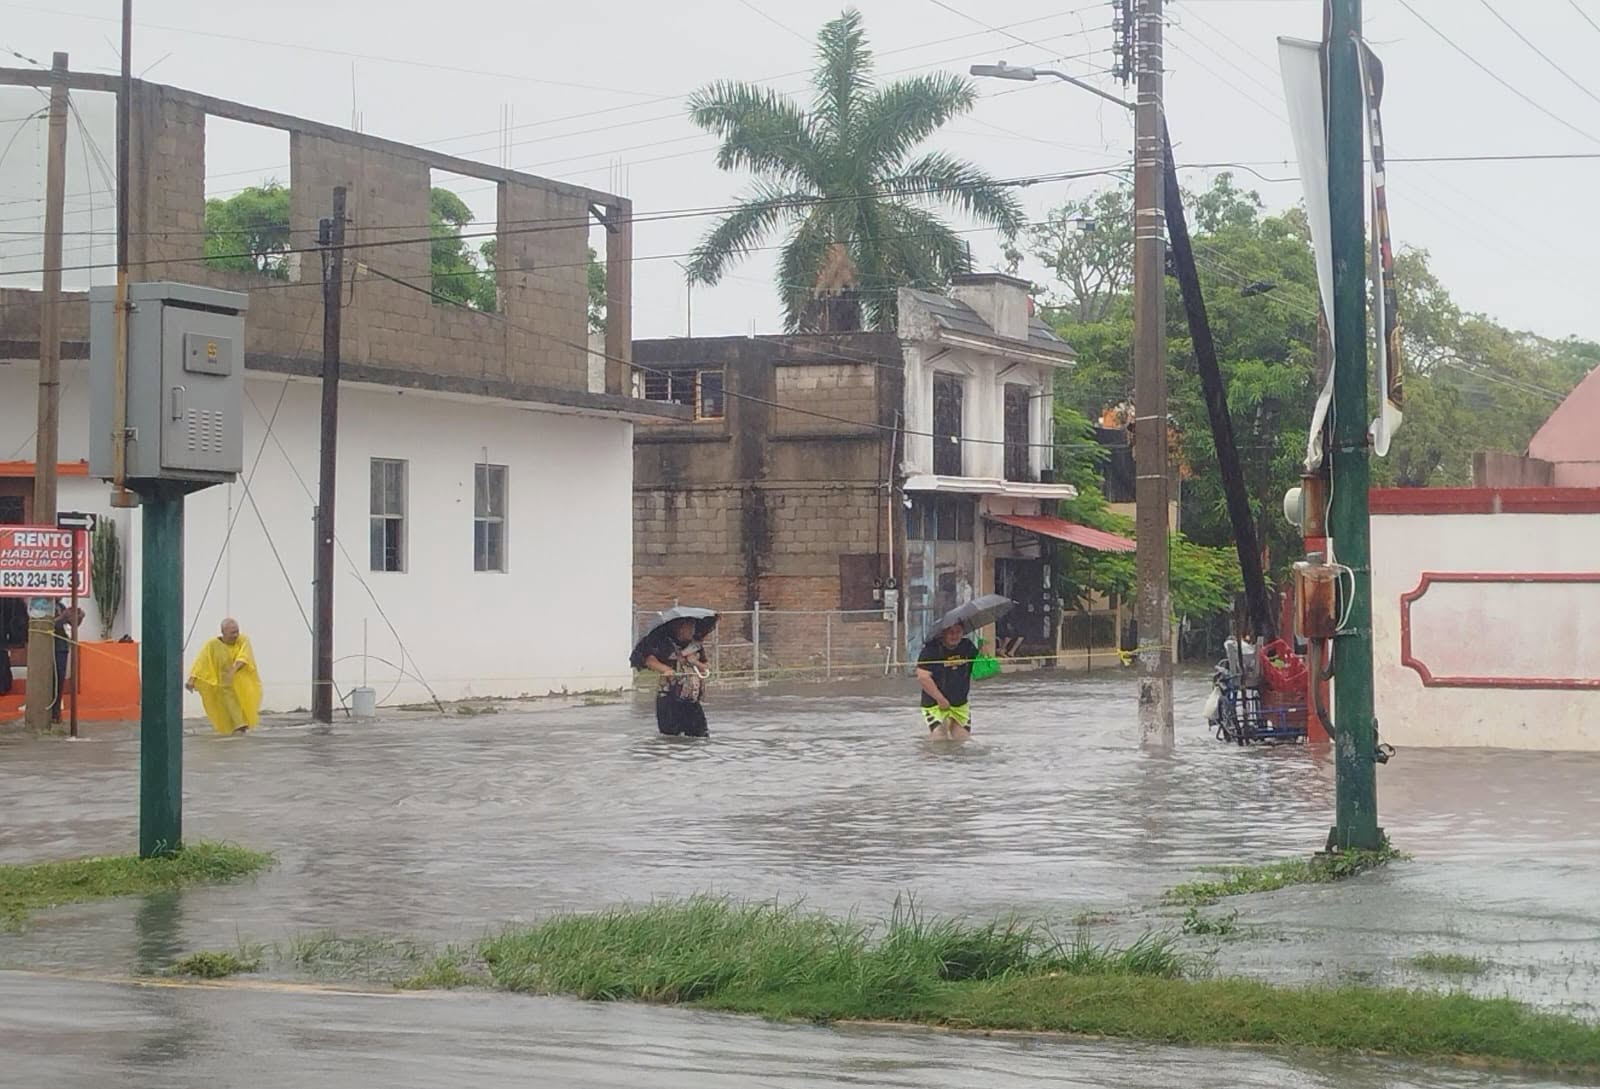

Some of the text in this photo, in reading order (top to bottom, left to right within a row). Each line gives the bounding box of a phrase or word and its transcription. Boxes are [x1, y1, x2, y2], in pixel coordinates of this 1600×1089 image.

[14, 532, 73, 547] RENTO
[4, 572, 24, 587] 833
[27, 573, 47, 587] 234
[51, 573, 64, 587] 56
